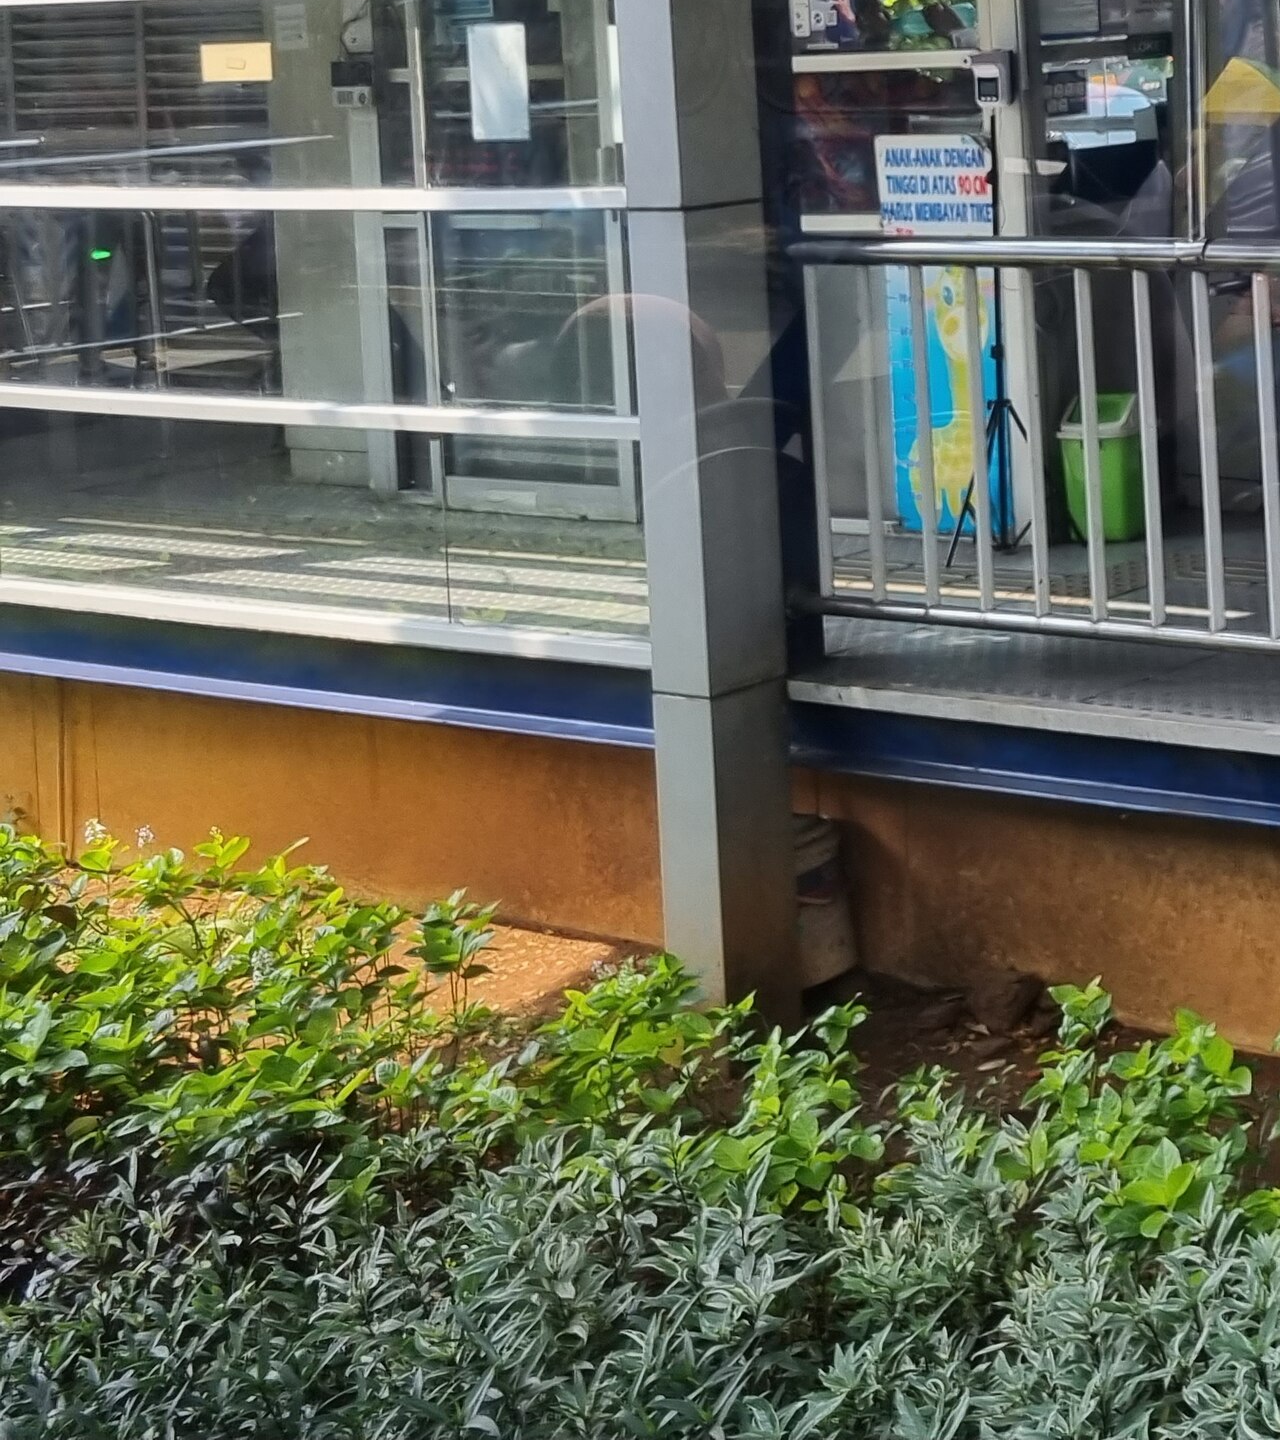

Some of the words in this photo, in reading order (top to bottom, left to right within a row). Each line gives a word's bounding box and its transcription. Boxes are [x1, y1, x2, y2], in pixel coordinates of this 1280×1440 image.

[885, 148, 942, 167] ANAK-ANAK
[943, 148, 985, 168] DENGAN
[886, 175, 918, 194] TINGGI
[920, 175, 930, 194] DI
[931, 175, 956, 195] ATAS
[958, 175, 971, 195] 90
[881, 202, 913, 221] HARUS
[915, 202, 967, 222] MEMBAYAR
[969, 203, 993, 223] TIKE
